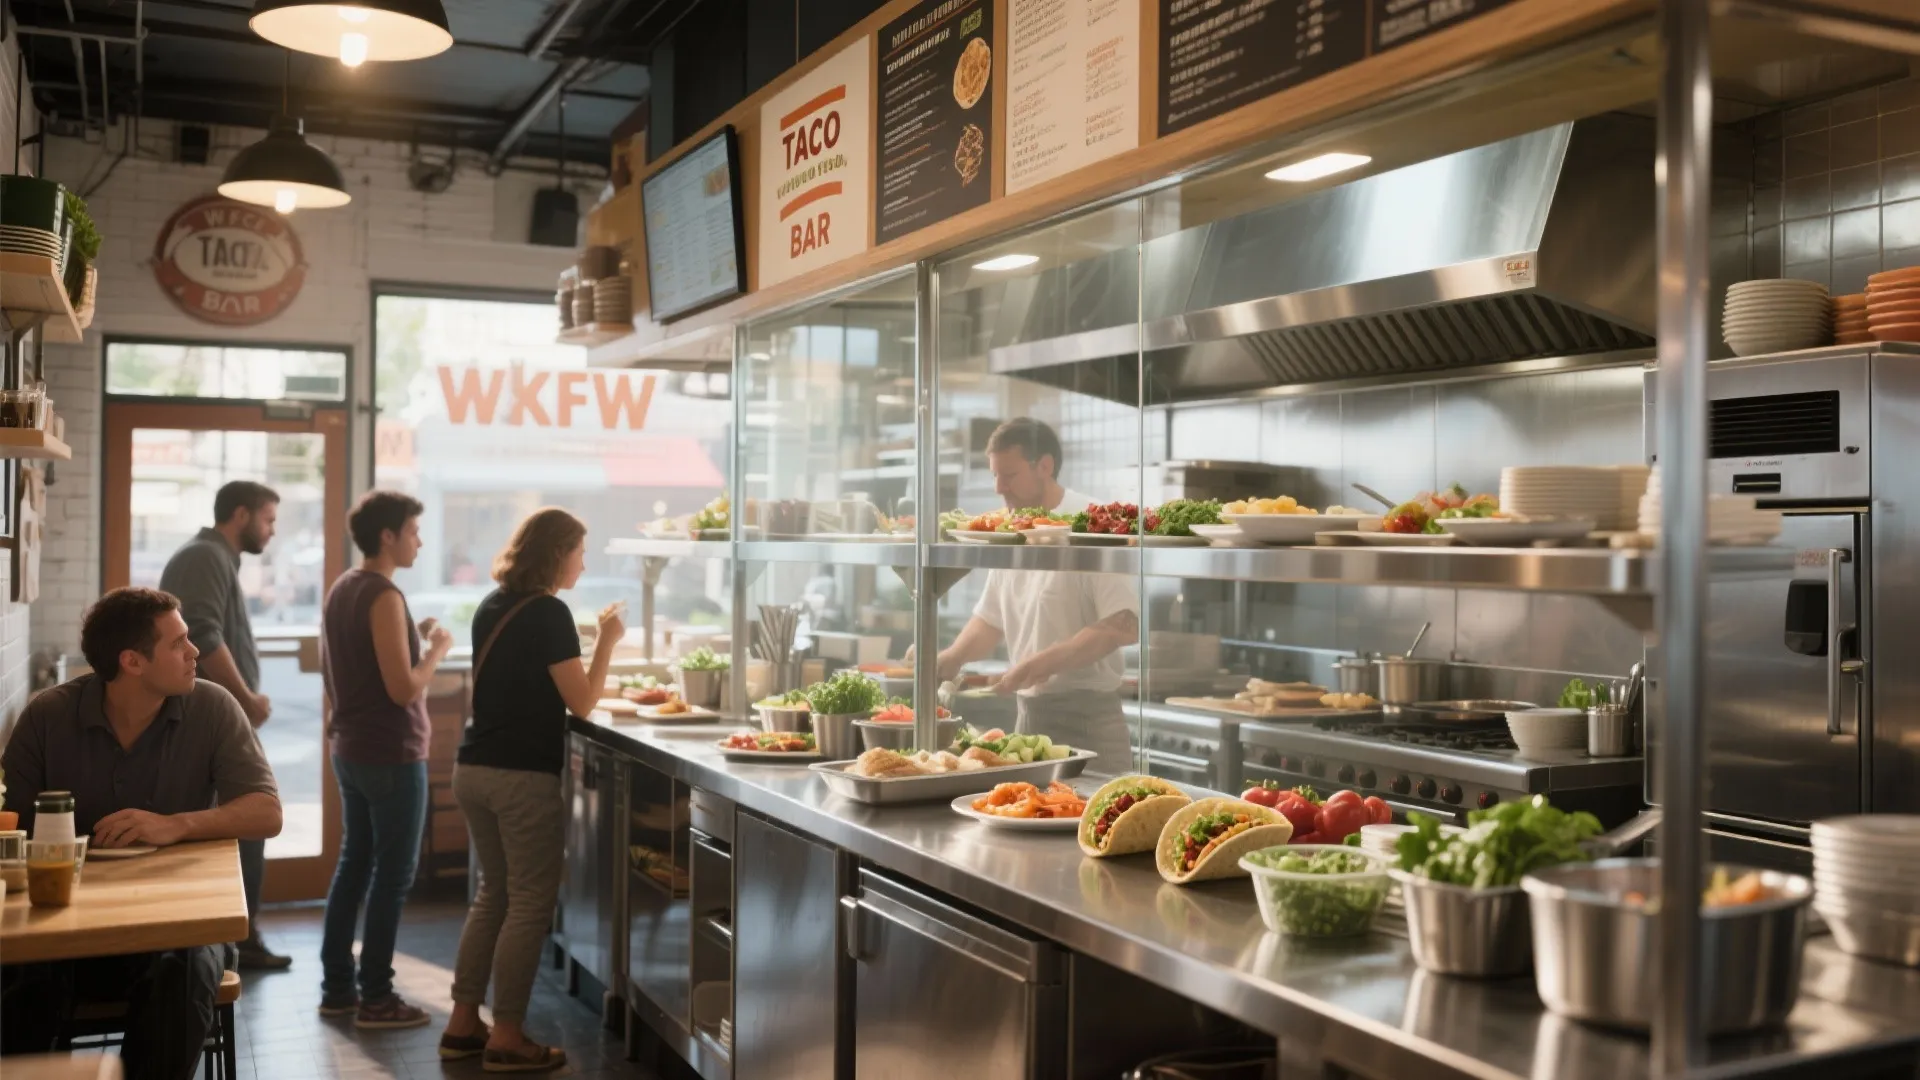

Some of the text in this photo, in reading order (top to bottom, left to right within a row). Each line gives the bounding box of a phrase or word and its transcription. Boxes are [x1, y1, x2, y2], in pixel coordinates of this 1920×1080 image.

[783, 111, 840, 170] TACO
[791, 212, 831, 259] BAR
[202, 290, 261, 314] BAR
[437, 364, 657, 430] WKFW
